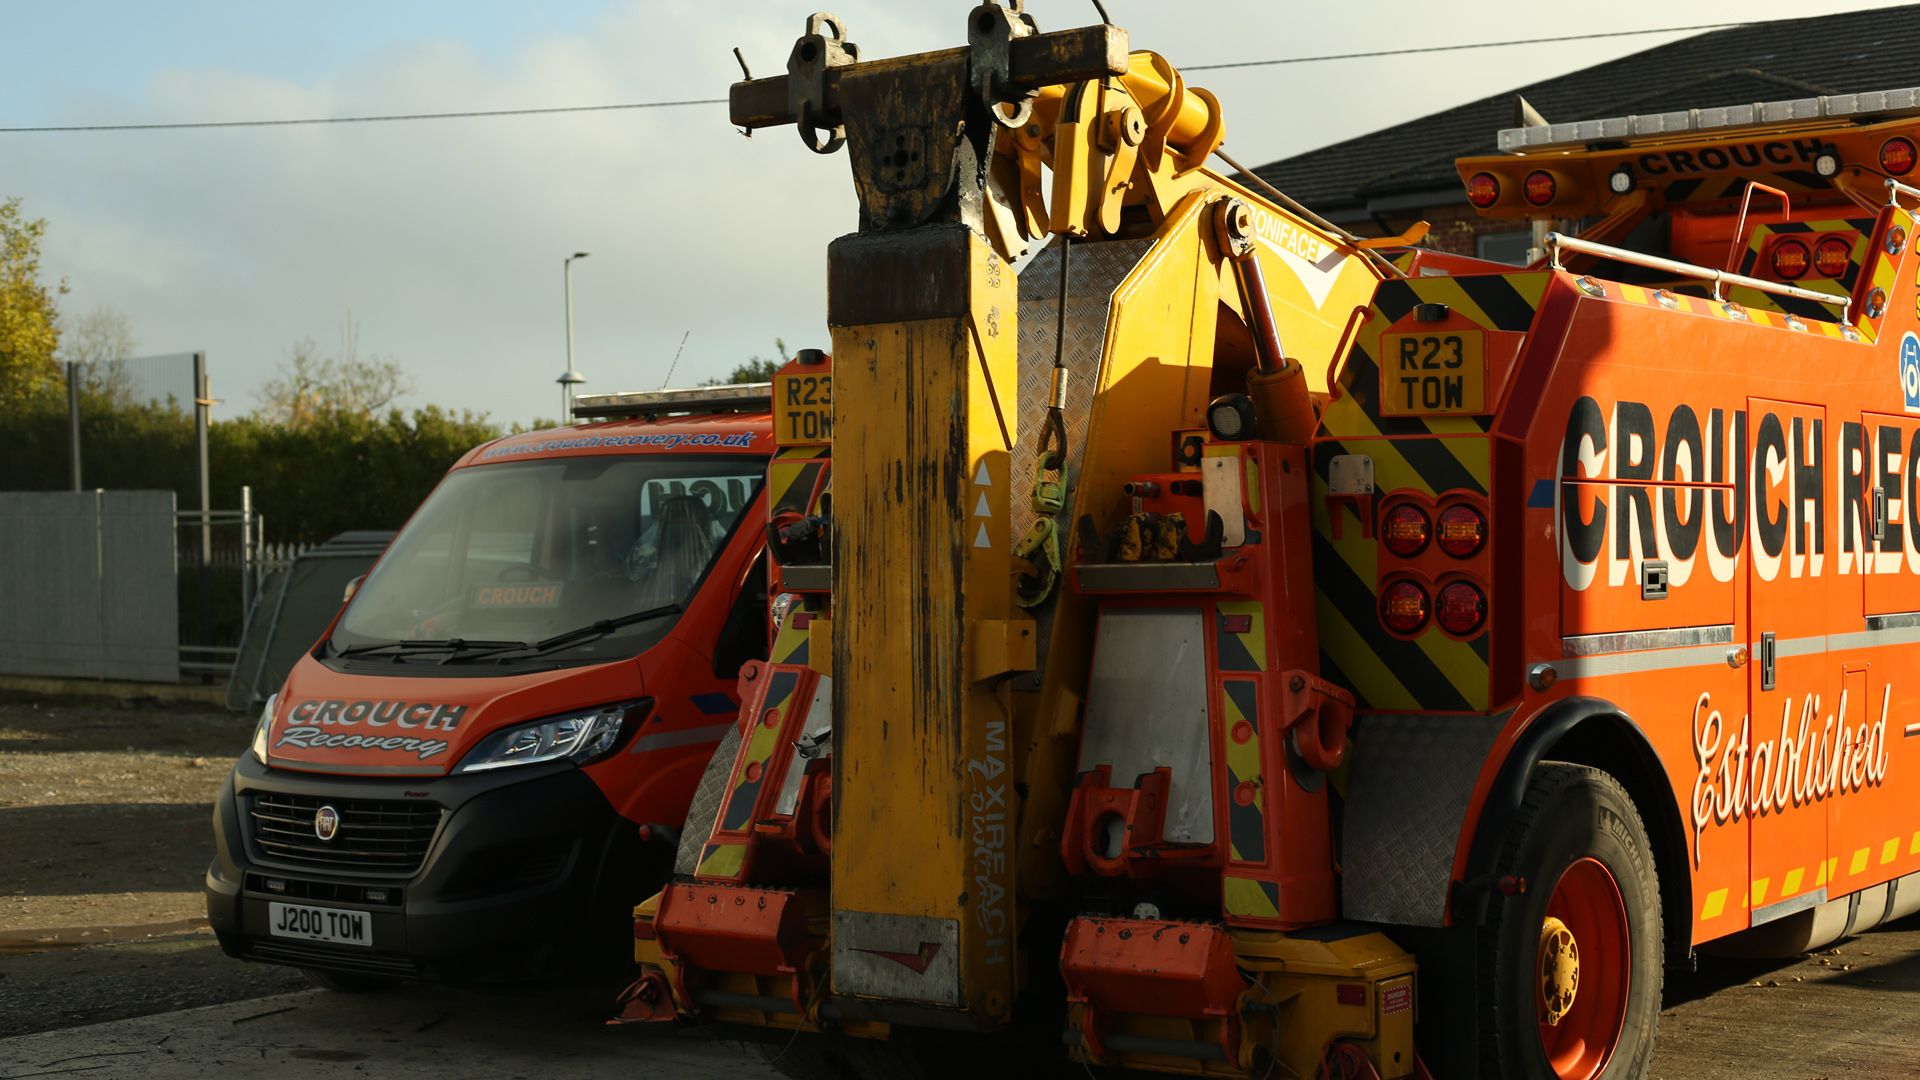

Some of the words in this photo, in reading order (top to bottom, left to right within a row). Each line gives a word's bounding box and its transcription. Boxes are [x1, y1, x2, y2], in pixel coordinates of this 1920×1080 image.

[1638, 138, 1824, 176] CROUCH
[1400, 335, 1463, 370] R23
[787, 376, 832, 406] R23
[1400, 375, 1463, 409] TOW
[483, 431, 758, 459] www.crouchrecovery.co.uk
[1555, 396, 1824, 591] CROUCH
[480, 585, 557, 605] CROUCH
[287, 699, 469, 731] CROUCH
[274, 725, 448, 760] Recovery
[1691, 683, 1892, 873] Established
[985, 720, 1006, 966] MAXIREACH
[277, 907, 323, 935] J200
[327, 912, 363, 940] TOW
